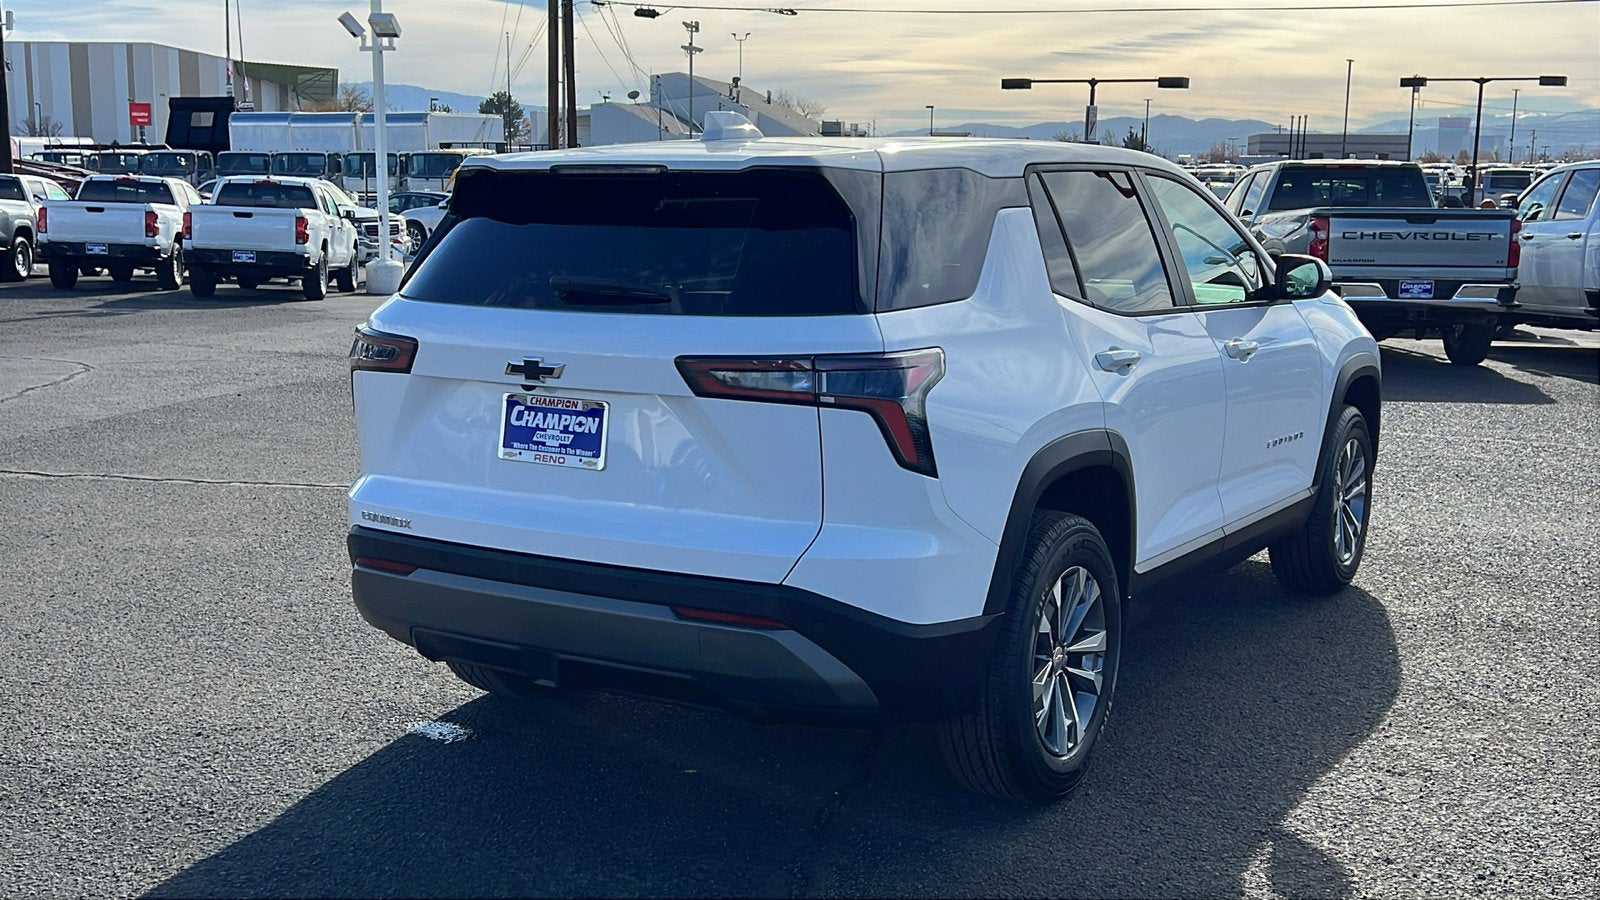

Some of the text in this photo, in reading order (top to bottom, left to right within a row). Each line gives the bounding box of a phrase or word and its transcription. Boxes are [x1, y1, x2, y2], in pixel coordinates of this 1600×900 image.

[1342, 231, 1499, 241] CHEVROLET
[530, 396, 578, 409] CHAMPION
[510, 405, 600, 434] CHAMPION
[535, 432, 571, 443] CHEVROLET
[528, 443, 538, 451] The
[538, 444, 561, 453] Customer
[566, 447, 576, 455] The
[533, 453, 566, 465] RENO
[361, 509, 413, 529] EQUINOX
